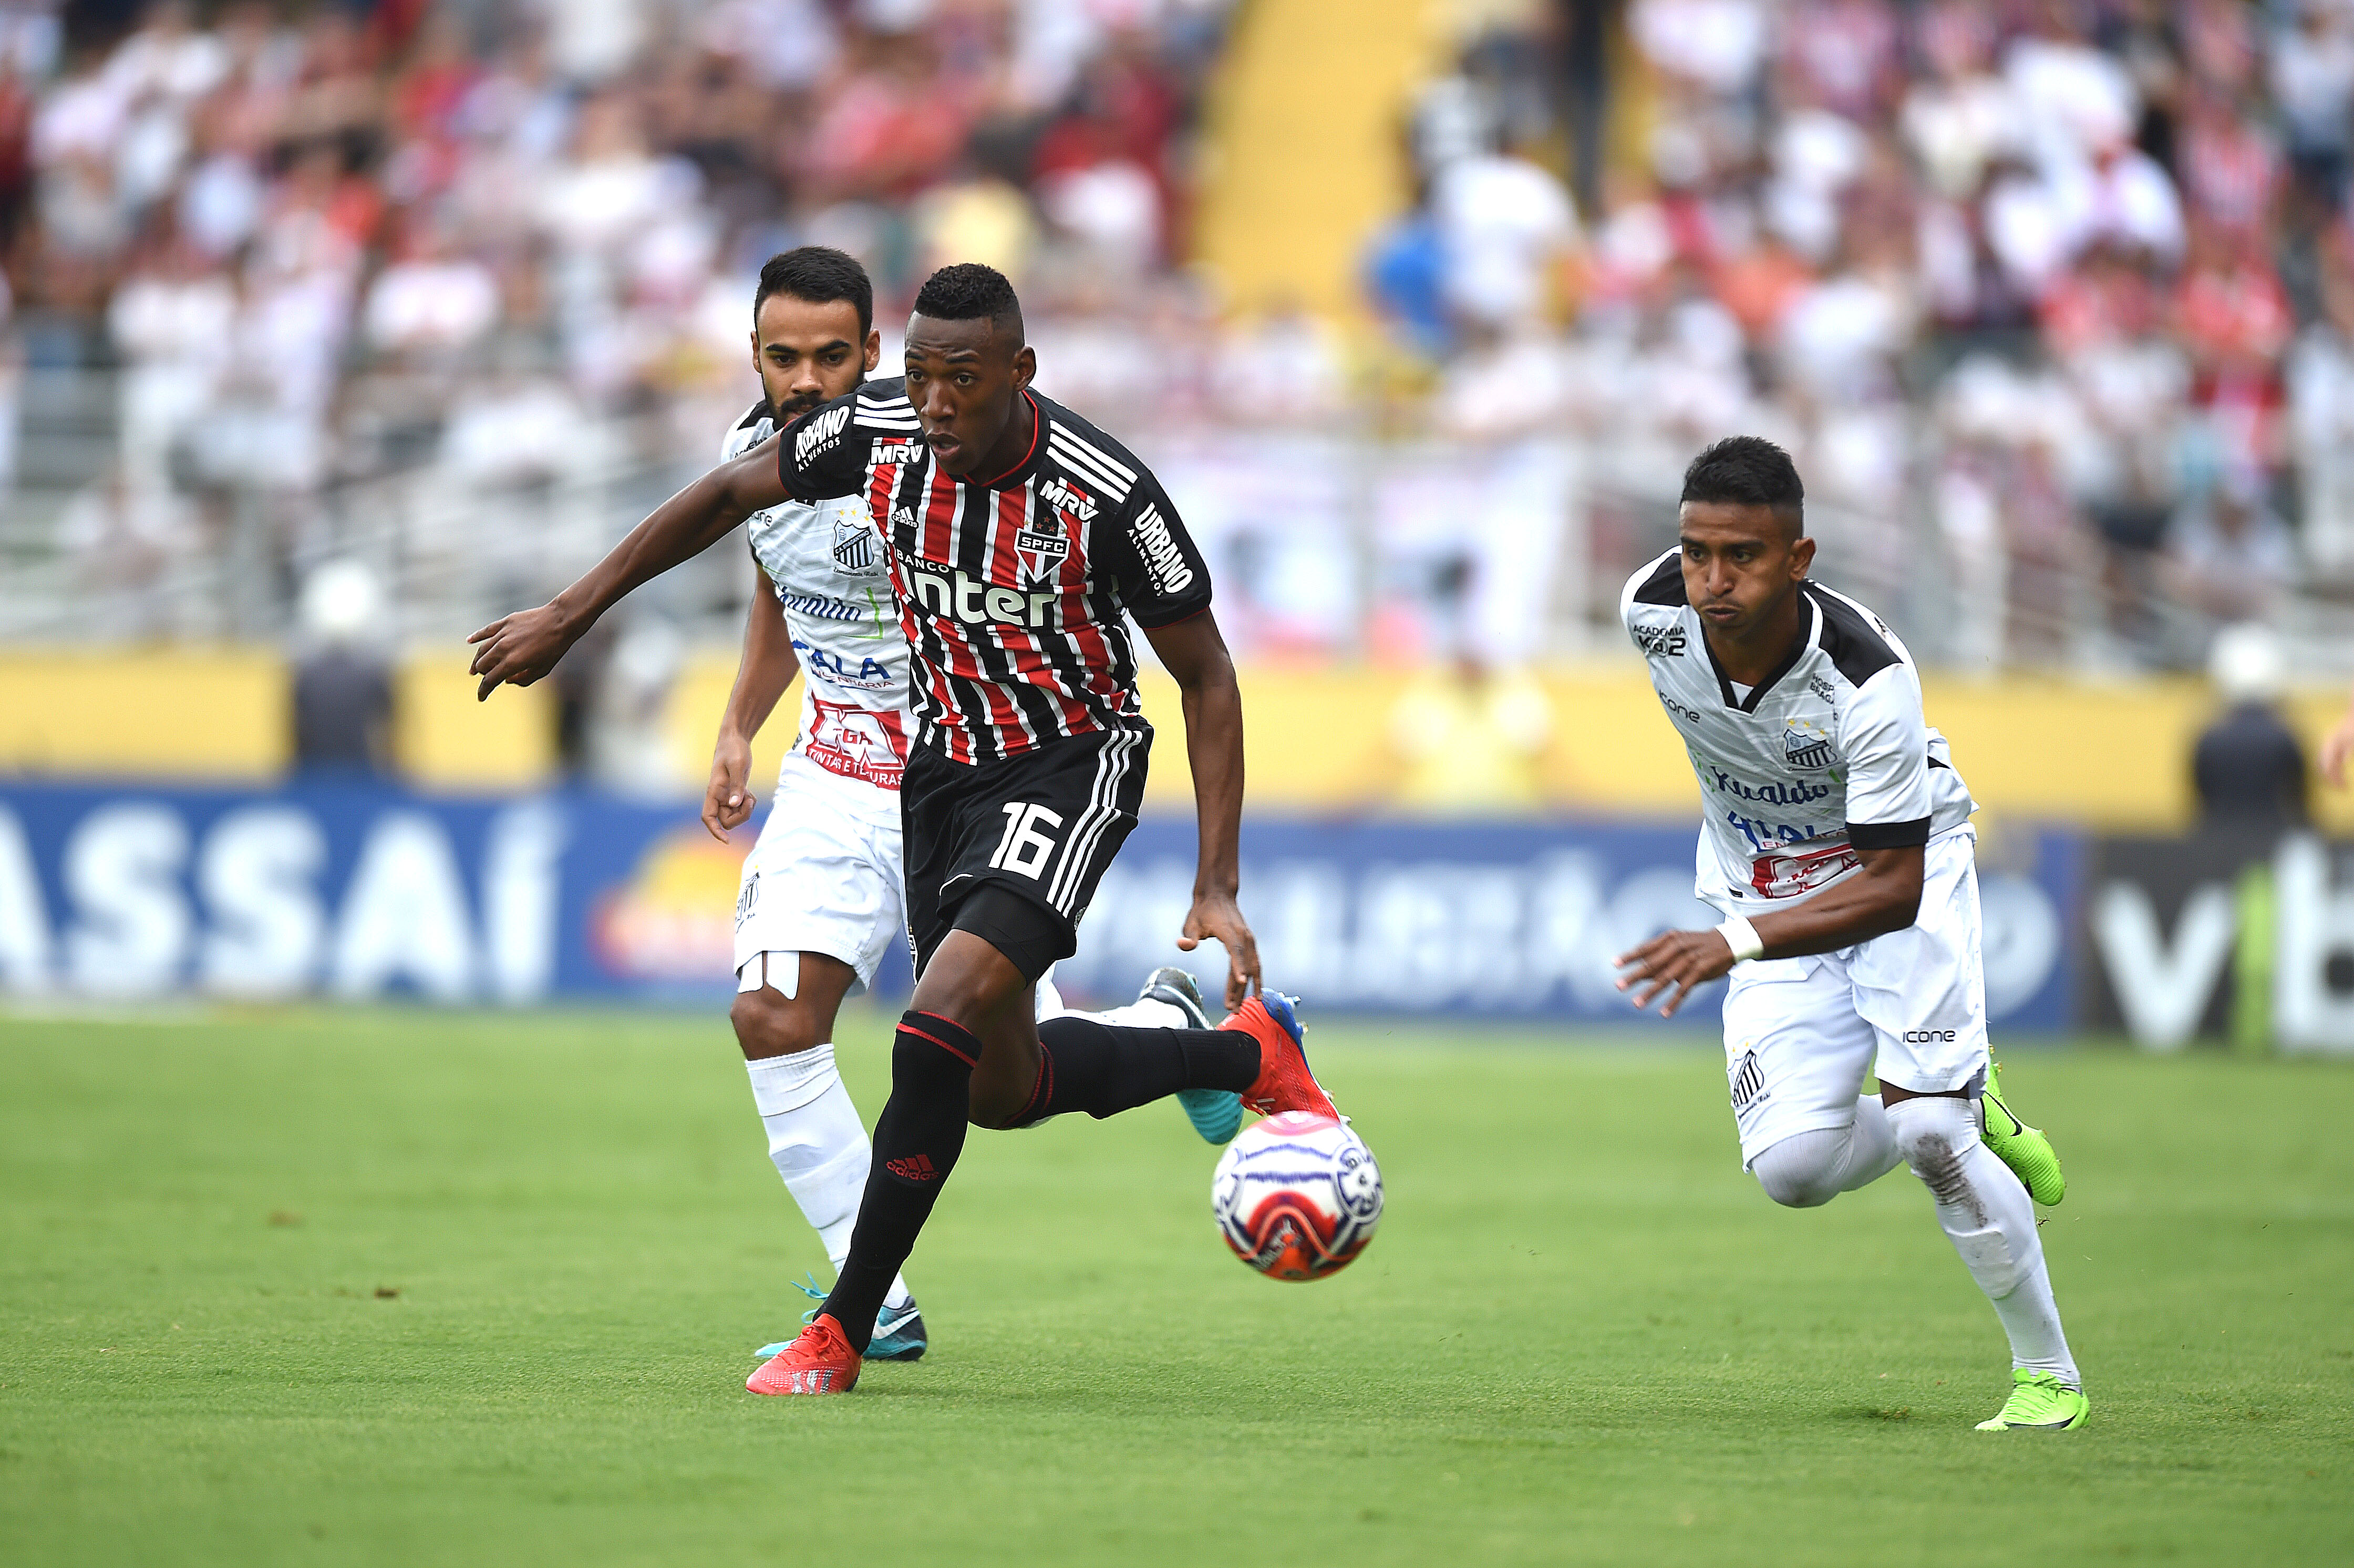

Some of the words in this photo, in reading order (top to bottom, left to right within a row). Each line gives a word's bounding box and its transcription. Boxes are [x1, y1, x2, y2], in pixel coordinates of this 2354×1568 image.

[870, 444, 924, 465] MRV
[1039, 479, 1099, 521] MRV
[892, 514, 918, 528] adidas
[1021, 537, 1065, 553] SPFC
[1134, 501, 1194, 594] URBANO
[895, 548, 951, 574] BANCO
[1127, 528, 1164, 597] ALIMENTOS
[843, 760, 851, 772] E
[988, 801, 1065, 881] 16
[1902, 1029, 1956, 1044] icone
[886, 1161, 939, 1181] adidas
